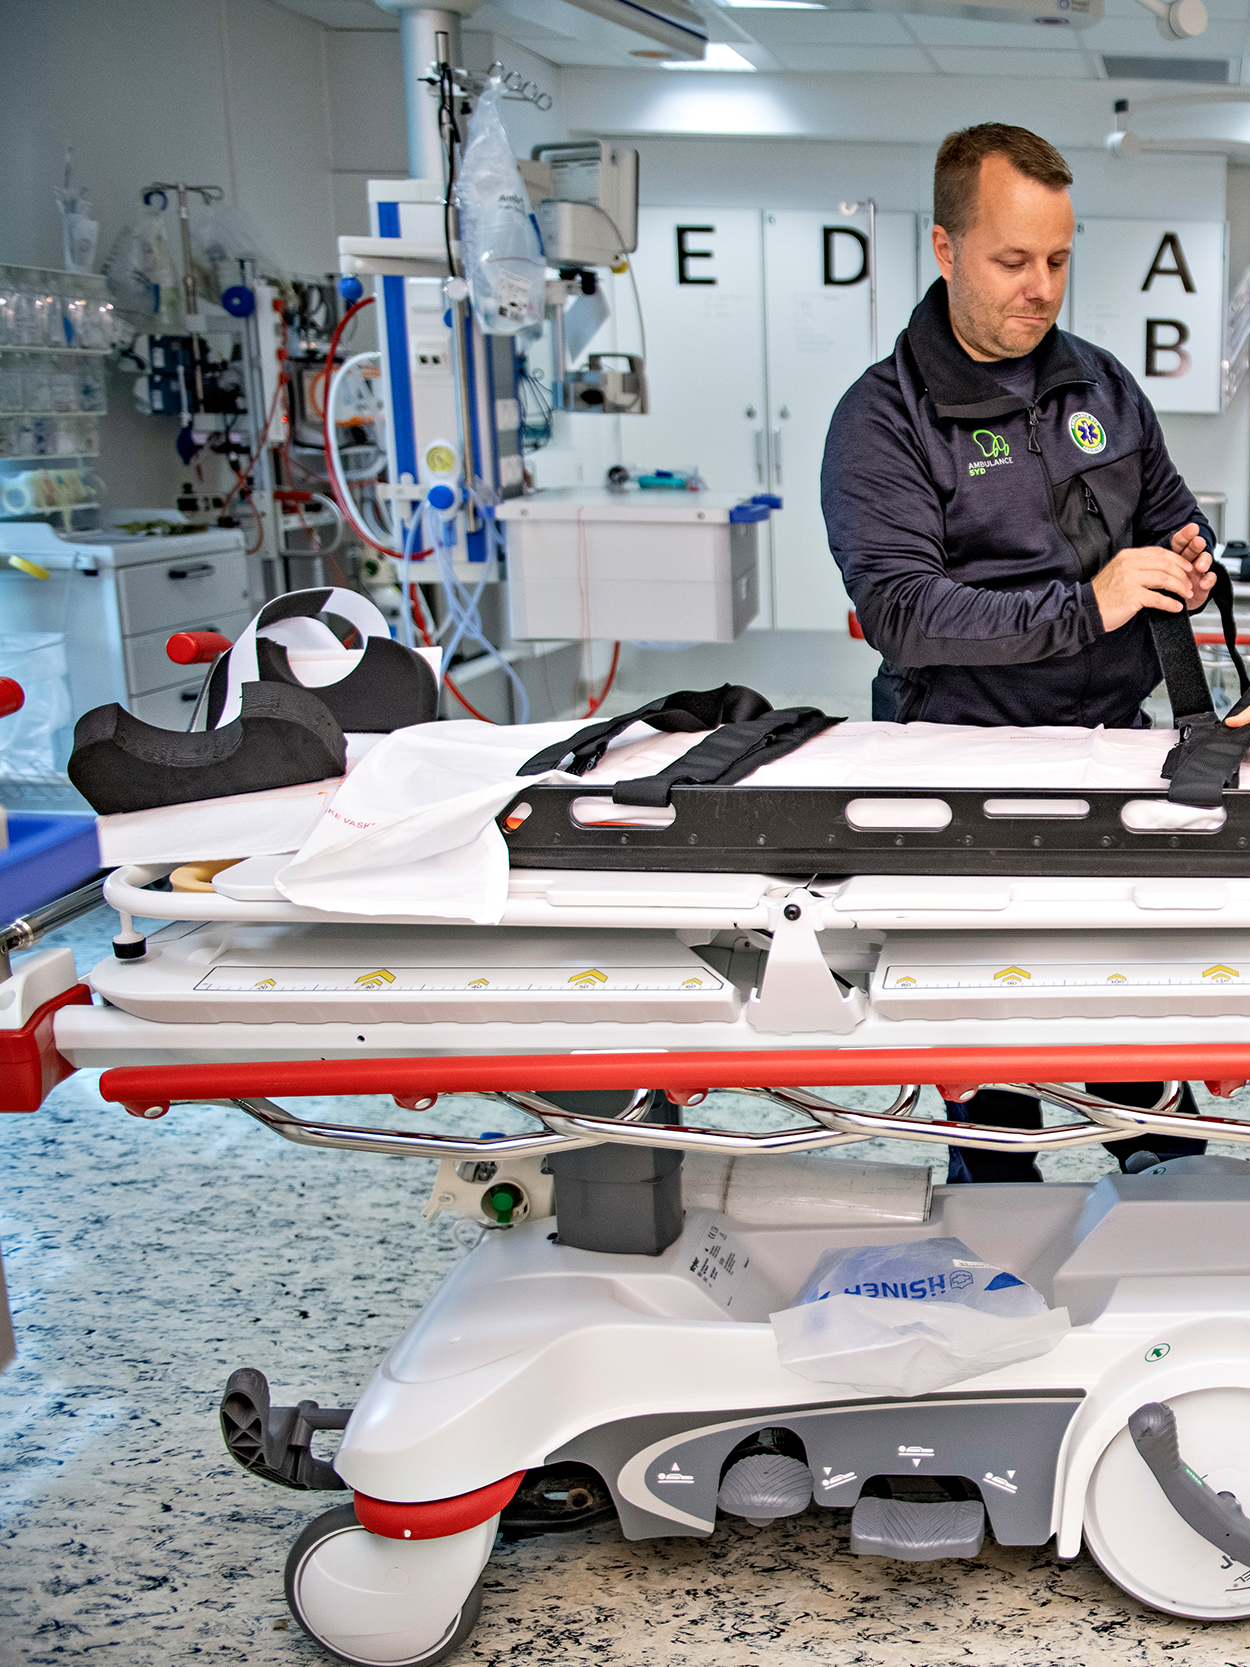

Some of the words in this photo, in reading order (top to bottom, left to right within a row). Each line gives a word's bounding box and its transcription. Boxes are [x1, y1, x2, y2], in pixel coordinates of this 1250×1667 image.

[676, 225, 717, 286] E
[822, 225, 869, 286] D
[1140, 232, 1198, 294] A
[1145, 318, 1191, 378] B
[968, 457, 1013, 470] AMBULANCE
[969, 468, 986, 477] SYD
